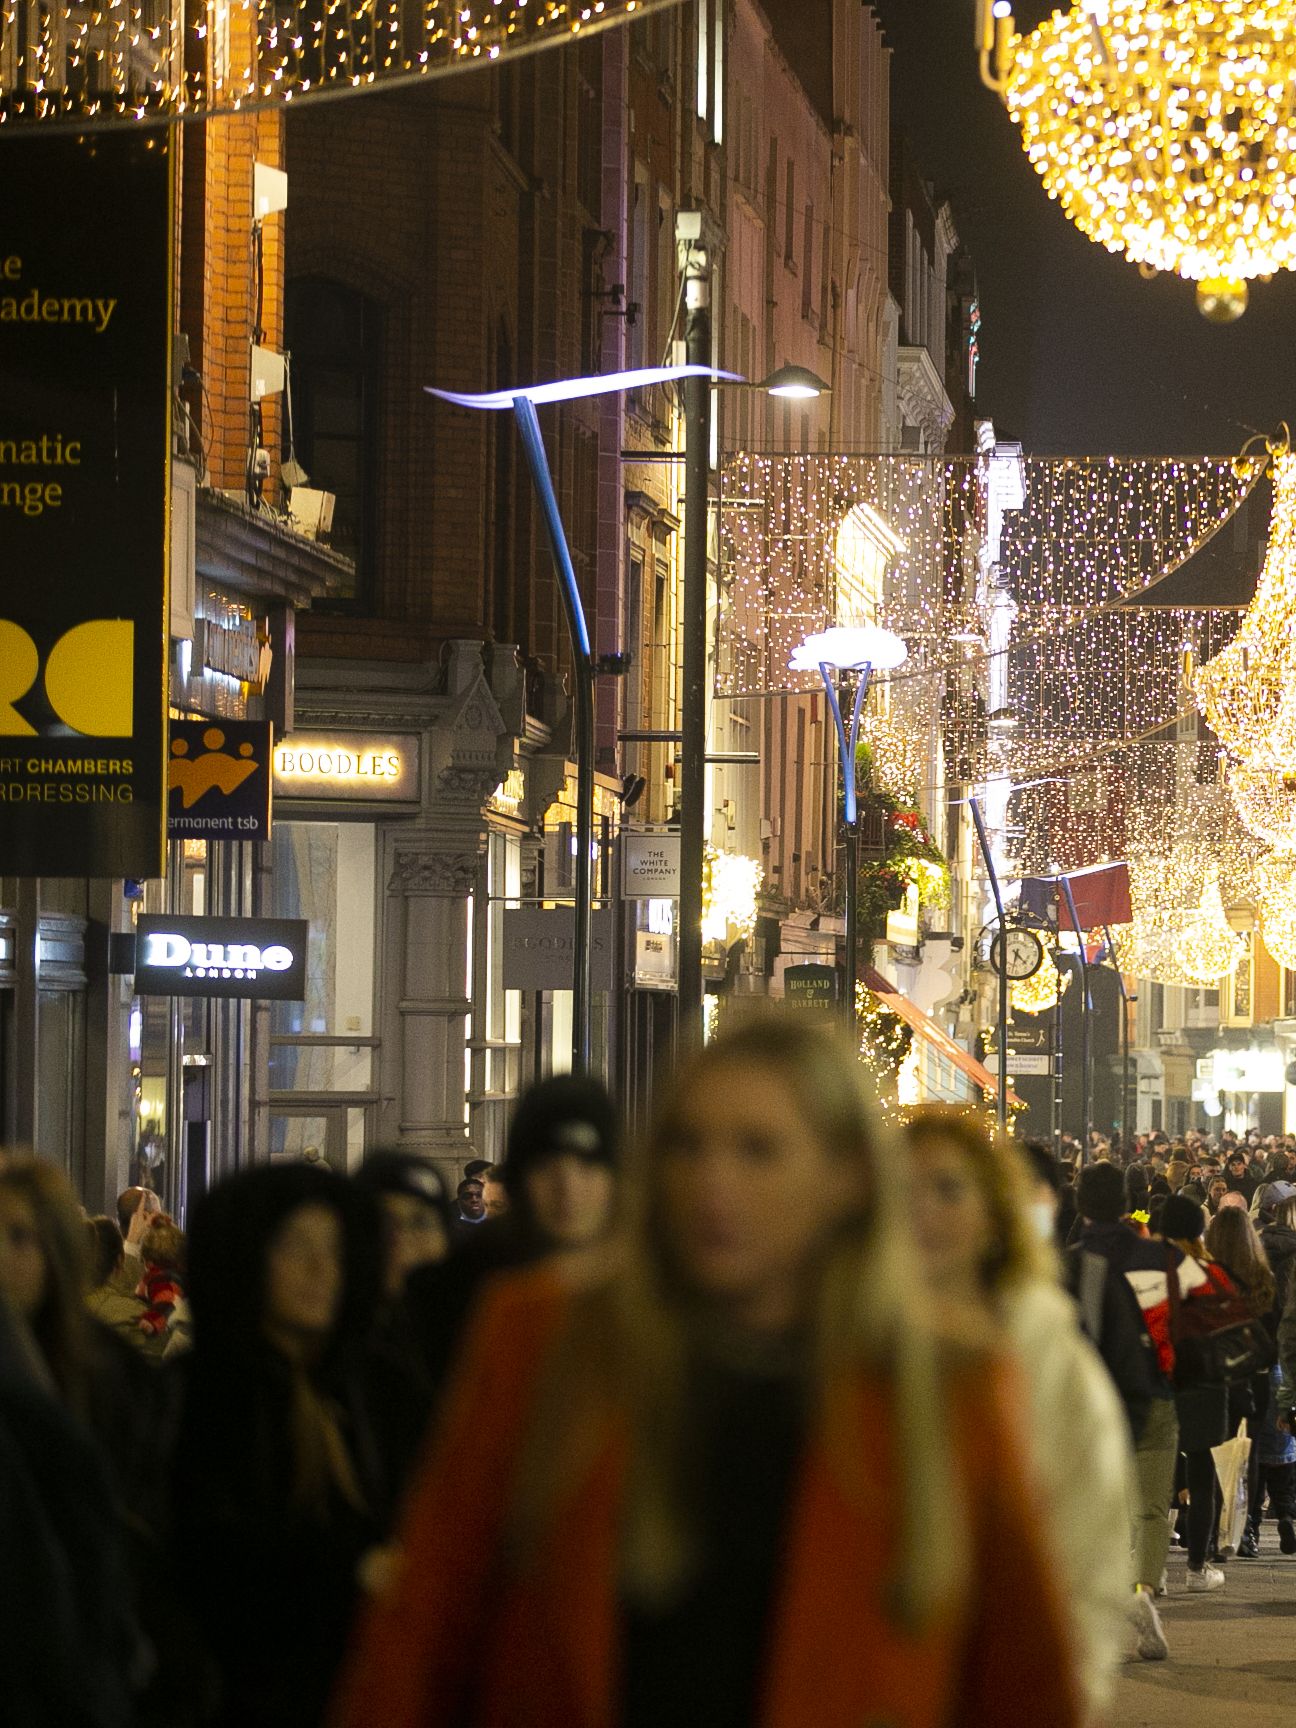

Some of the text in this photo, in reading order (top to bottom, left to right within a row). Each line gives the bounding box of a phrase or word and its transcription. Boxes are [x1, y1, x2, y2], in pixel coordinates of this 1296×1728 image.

[27, 758, 133, 774] CHAMBERS
[278, 752, 400, 776] BOODLES
[168, 815, 259, 830] ermanent tsb
[147, 933, 293, 971] Dune
[185, 967, 257, 980] LONDON
[790, 980, 830, 990] HOLLAND
[791, 1000, 829, 1009] BARRETT
